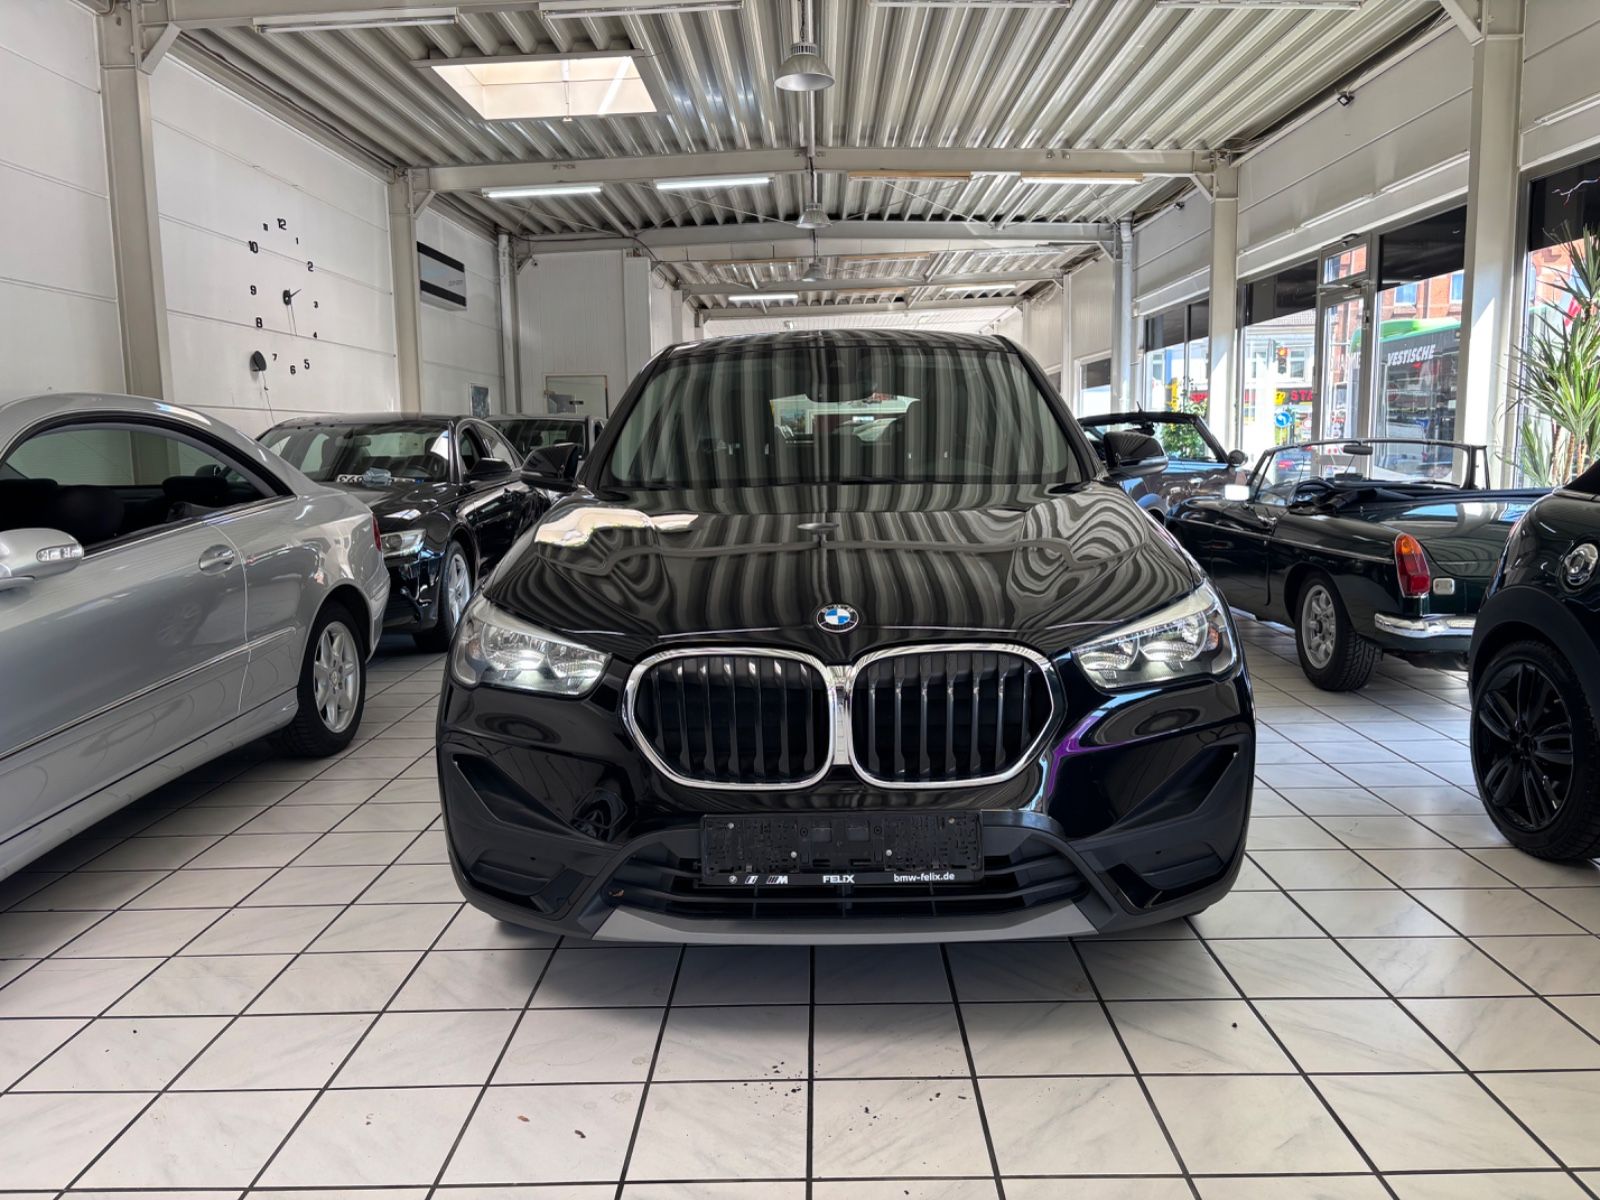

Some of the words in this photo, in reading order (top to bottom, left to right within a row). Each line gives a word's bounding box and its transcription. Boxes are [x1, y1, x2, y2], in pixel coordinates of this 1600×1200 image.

[277, 218, 287, 231] 12
[295, 237, 299, 245] 1
[248, 240, 259, 254] 10
[307, 260, 314, 272] 2
[250, 285, 257, 295] 9
[313, 300, 319, 309] 3
[255, 316, 263, 329] 8
[272, 353, 278, 362] 7
[1386, 344, 1436, 367] VESTISCHE
[290, 364, 297, 375] 6
[304, 359, 310, 370] 5
[893, 872, 955, 883] bmw-felix.de
